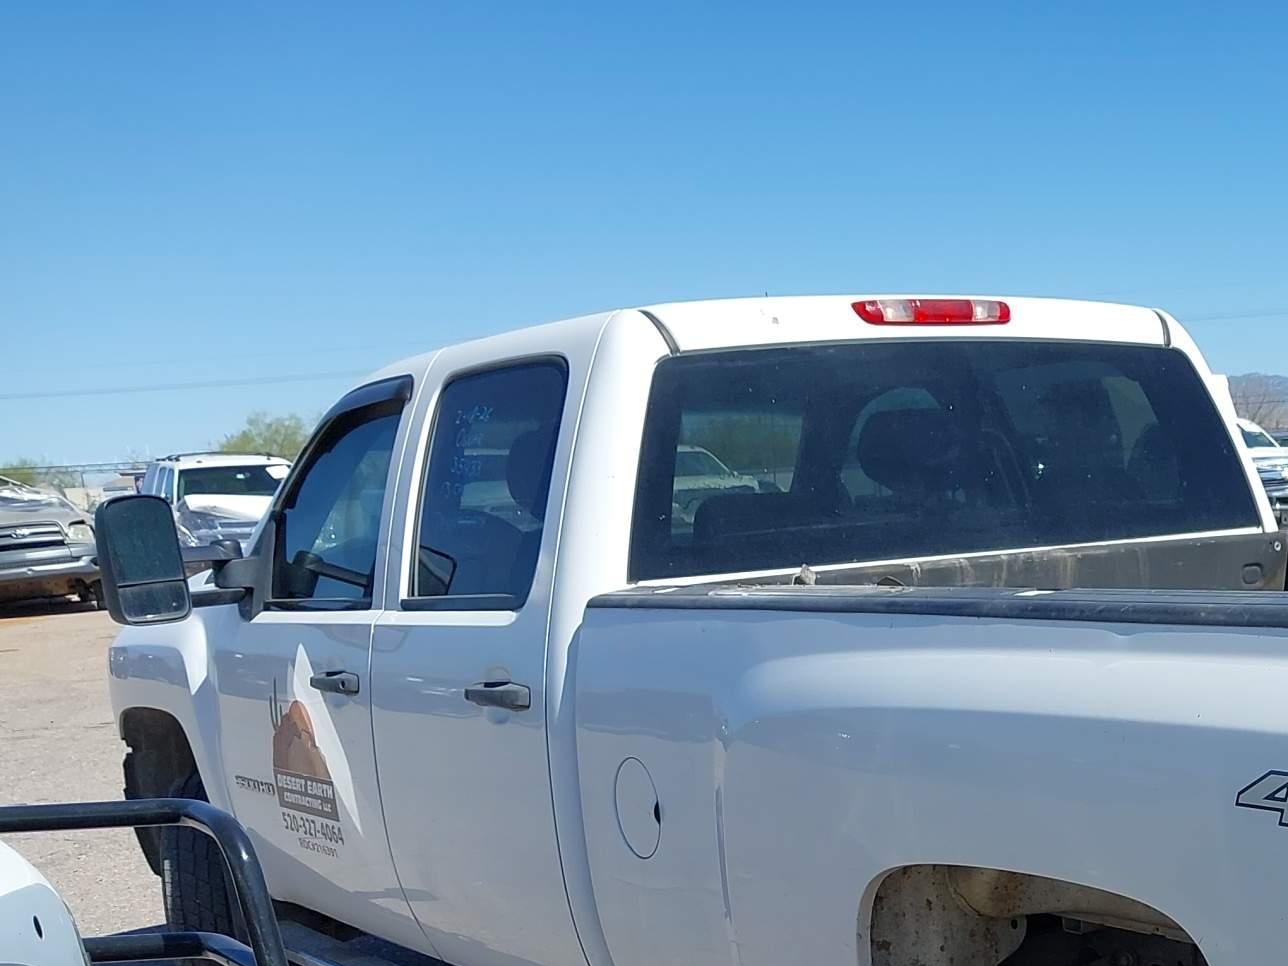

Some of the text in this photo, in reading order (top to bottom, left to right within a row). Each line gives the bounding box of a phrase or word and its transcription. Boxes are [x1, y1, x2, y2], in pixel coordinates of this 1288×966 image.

[277, 773, 333, 799] DESERT EARTH
[283, 791, 332, 812] CONTRACTING LLC
[281, 811, 345, 846] 520-327-4064
